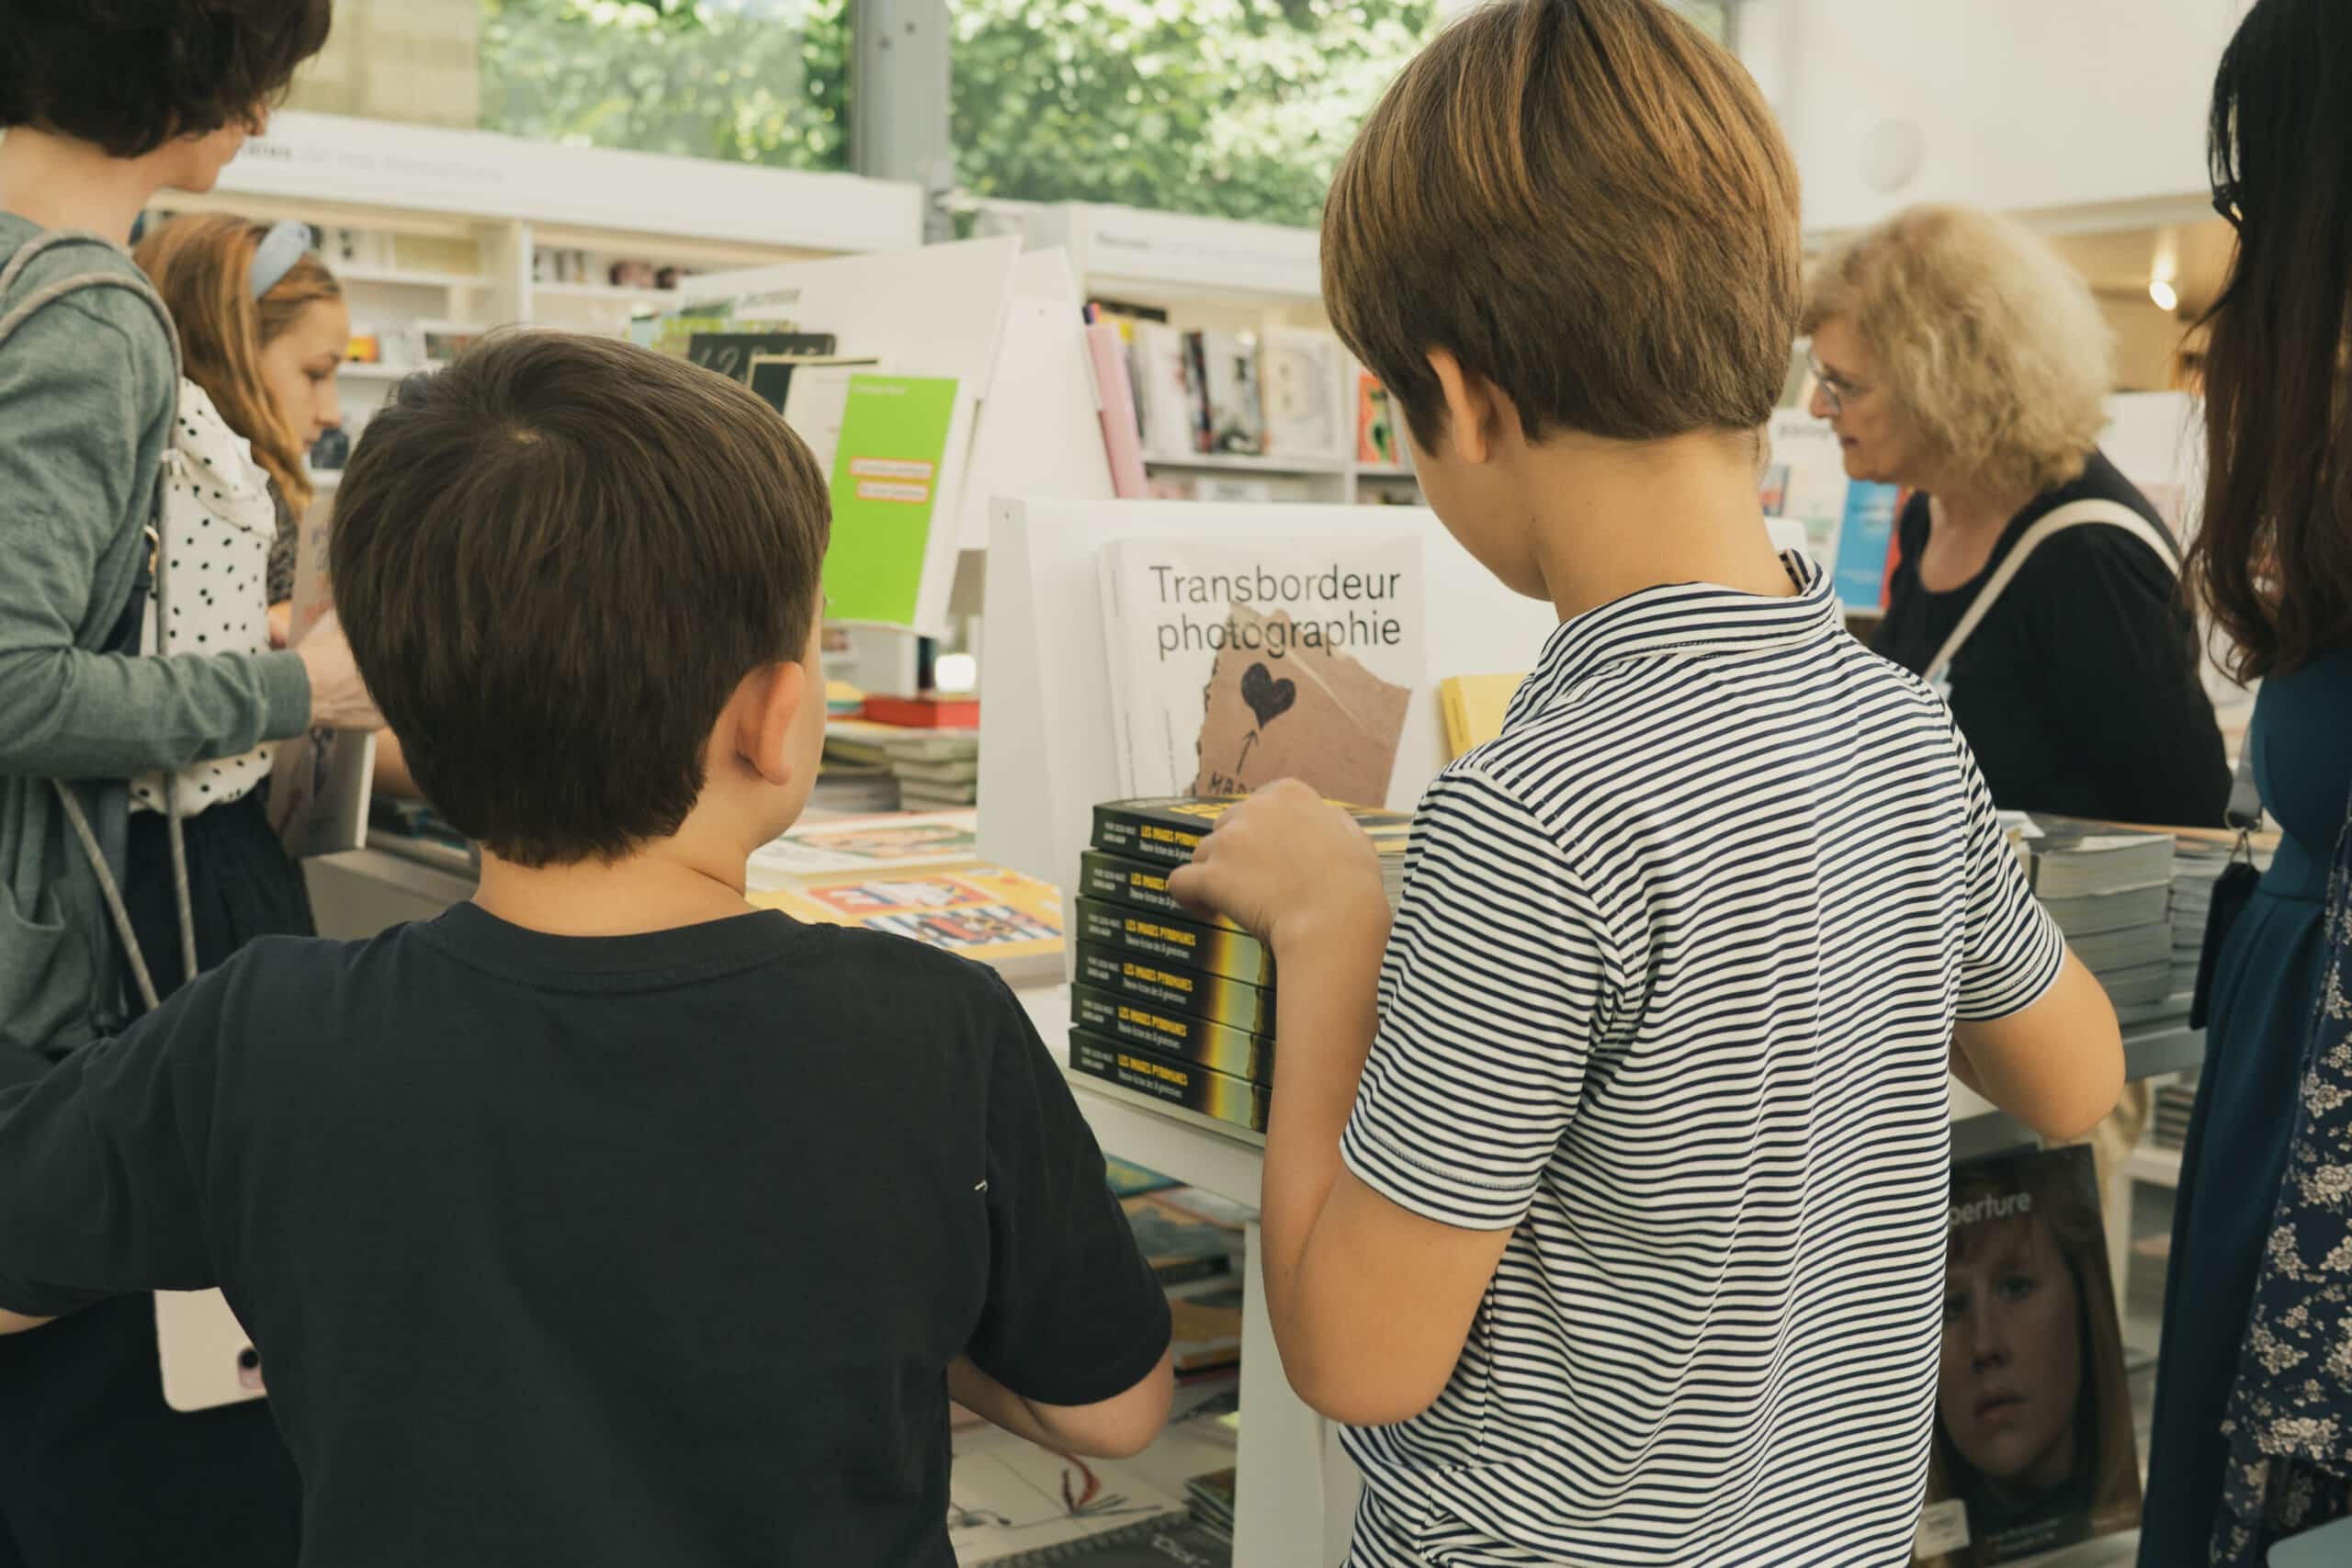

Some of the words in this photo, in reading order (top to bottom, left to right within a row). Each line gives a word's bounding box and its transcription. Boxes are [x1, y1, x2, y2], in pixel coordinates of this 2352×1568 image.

[1149, 564, 1401, 604] Transbordeur
[1157, 610, 1401, 661] photographie
[1949, 1192, 2030, 1232] perture
